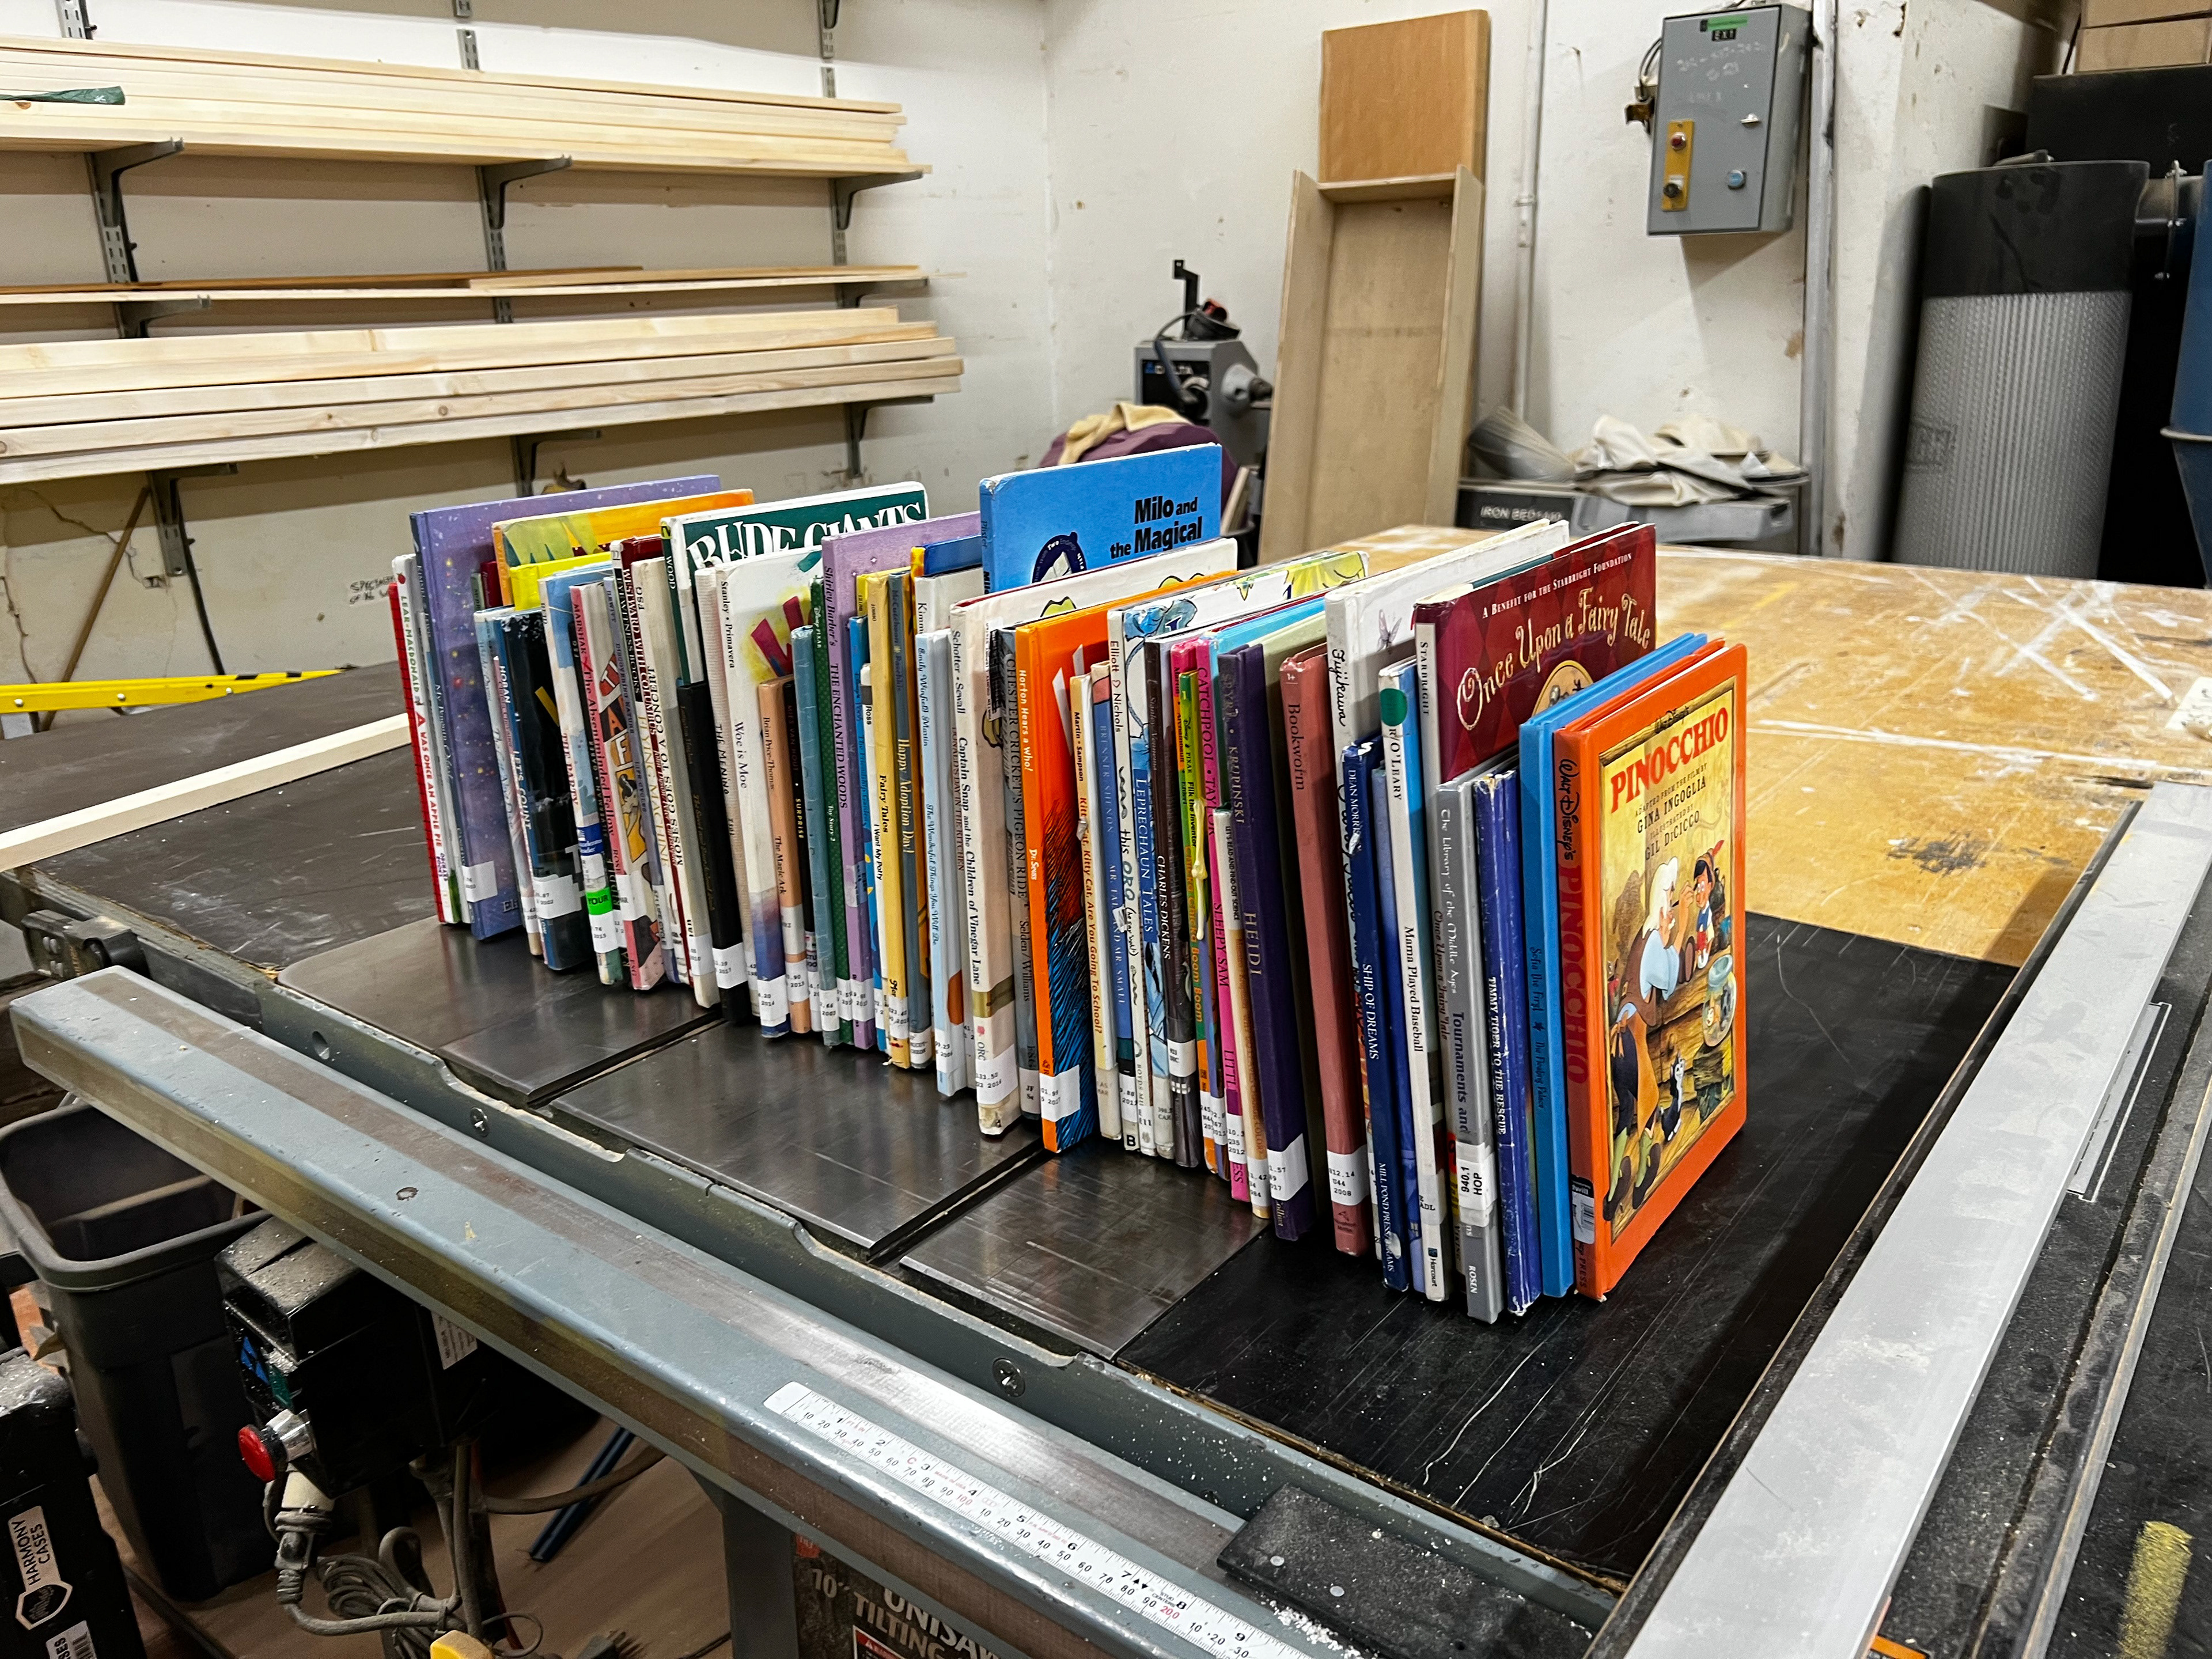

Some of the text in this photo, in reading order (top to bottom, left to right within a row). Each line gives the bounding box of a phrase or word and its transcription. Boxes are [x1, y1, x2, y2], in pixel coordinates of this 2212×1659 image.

[1110, 541, 1131, 559] the
[1134, 517, 1202, 554] Magical
[1134, 495, 1198, 524] Milo and
[666, 556, 676, 589] WOOD
[686, 521, 796, 569] RUDE
[824, 566, 838, 646] Shirley Barber's
[1483, 552, 1632, 619] A BENEFIT FOR THE STARBRIGHT FOUNDATION
[573, 604, 587, 654] MARSHAK
[616, 578, 641, 694] EYEWITNESS BOOKS
[623, 569, 657, 735] WESTWARD WITH COLUMBUS
[721, 581, 736, 668] Stanley Primavera
[499, 665, 511, 703] HOBAN
[952, 630, 966, 714] Schotter Sewall
[1110, 641, 1124, 732] Elliott Nichols
[1329, 649, 1350, 726] Fujikawa
[1420, 641, 1429, 716] STARBRIGHT
[1456, 586, 1651, 731] Once Upon a Fairy Tale
[763, 717, 771, 737] Brian
[918, 648, 930, 747] Emily Winfield Martin
[1019, 670, 1027, 704] Horton
[1024, 747, 1033, 771] Who!
[1198, 667, 1214, 760] CATCHPOOL
[583, 671, 616, 836] The Absentminded Fellow
[734, 721, 749, 788] Woe is Moe
[831, 664, 848, 808] THE ENCHANTED WOODS
[957, 737, 969, 779] Captain
[1074, 711, 1085, 782] Martin Sampson
[1288, 704, 1306, 790] Bookworm
[1611, 707, 1728, 813] PINOCCHIO
[415, 711, 442, 847] A WAS ONCE AN APPLE PIE
[513, 751, 531, 830] LET'S COUNT
[562, 733, 578, 805] THE PARTY
[639, 717, 668, 869] FLYING MACHINE
[879, 775, 888, 802] Fairy
[897, 739, 915, 853] Happy Adoption Day!
[960, 783, 971, 811] Snap
[1006, 658, 1027, 898] CHESTER CRICKET'S PIGEON RIDE
[1228, 747, 1245, 823] KRUPINSKI
[1347, 770, 1358, 796] DEAN
[1661, 786, 1675, 801] FROM
[795, 798, 804, 839] SURPRISE
[1637, 776, 1706, 834] GINA INGOGLIA
[777, 853, 785, 878] Magic
[1029, 849, 1040, 880] Dr. Seuss
[1120, 829, 1132, 854] this
[1136, 778, 1154, 932] LEPRECHAUN TALES
[778, 880, 787, 894] Ark
[965, 851, 976, 896] Children
[1441, 809, 1459, 994] The Library of the Middle Ages
[968, 900, 978, 911] of
[969, 915, 980, 956] Vinegar
[1157, 855, 1171, 960] CHARLES DICKENS
[972, 960, 982, 984] Lane
[1214, 903, 1230, 987] SLEEPY SAM
[1244, 912, 1262, 975] HEIDI
[1405, 926, 1423, 1052] Mama Played Baseball
[1530, 948, 1544, 1012] Sofia the First
[1362, 964, 1378, 1059] SHIP OF DREAMS
[1453, 1012, 1472, 1133] Tournaments and
[1488, 977, 1506, 1135] TIMMY TIGER TO THE RESCUE
[1334, 1188, 1352, 1196] 2008
[1378, 1163, 1390, 1210] MILL POND
[1461, 1166, 1470, 1192] 940.1
[1473, 1172, 1483, 1195] HOP
[1469, 1265, 1478, 1294] ROSEN
[886, 1456, 899, 1466] 60
[957, 1494, 974, 1505] 100
[1016, 1514, 1027, 1523] 5
[11, 1519, 41, 1586] HARMONY
[31, 1523, 50, 1564] CASES
[1067, 1542, 1078, 1551] 6
[1099, 1572, 1113, 1584] 70
[1121, 1570, 1131, 1578] 7
[1160, 1605, 1180, 1619] 200
[1176, 1601, 1187, 1609] 8
[1235, 1633, 1245, 1642] 9
